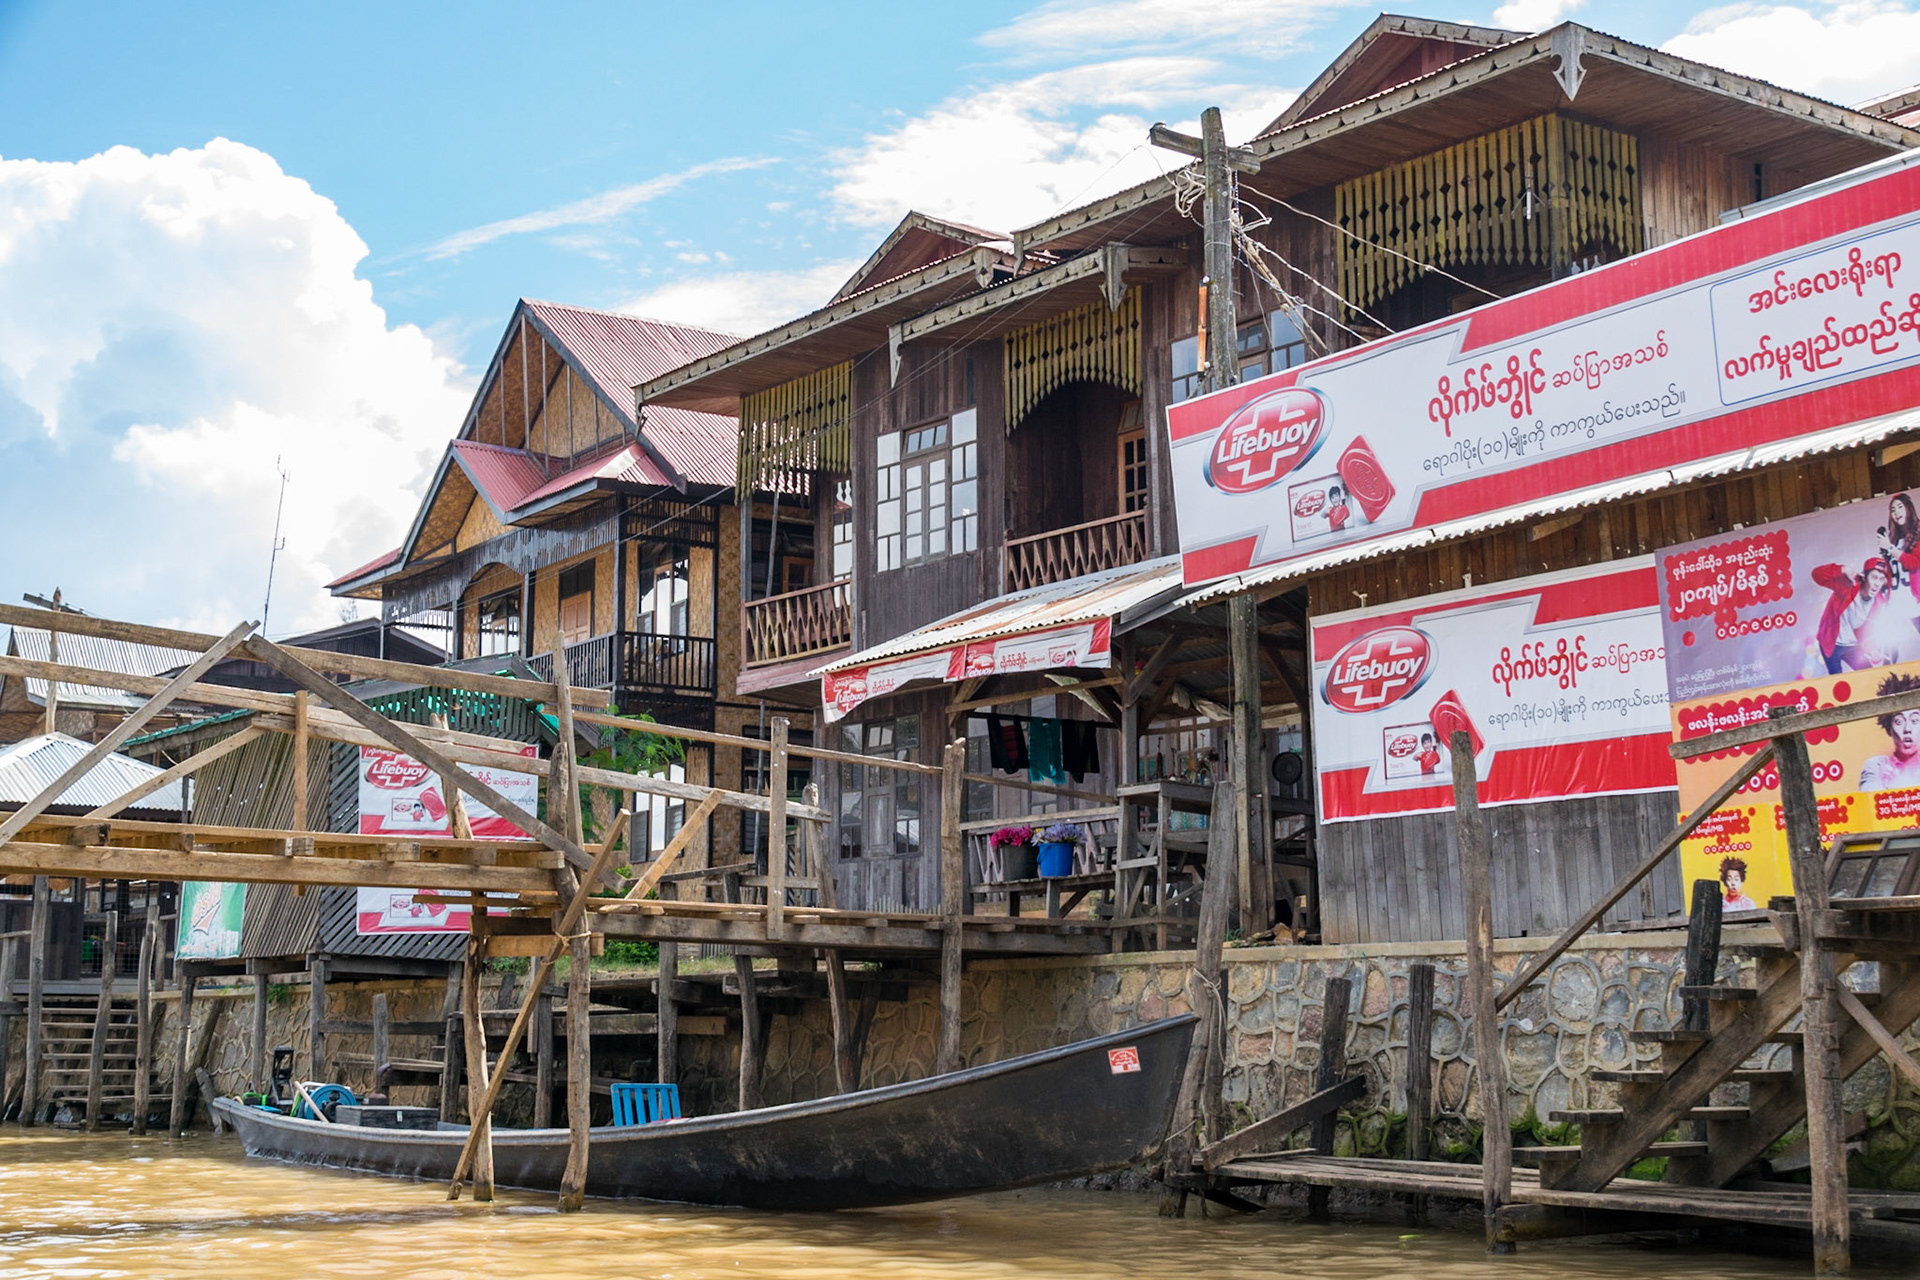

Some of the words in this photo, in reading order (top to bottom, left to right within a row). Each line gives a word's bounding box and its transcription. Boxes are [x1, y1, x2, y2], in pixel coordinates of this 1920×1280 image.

[1748, 247, 1901, 313] အင်းလေးရိုးရာ
[1428, 348, 1546, 437] လိုက်ဖ်ဘွိုင်
[1552, 329, 1669, 390] ဆပ်ပြာအသစ်
[1550, 383, 1686, 439] ကာကွယ်ပေးသည်။
[1216, 418, 1319, 464] Lifebuoy
[1717, 614, 1795, 638] ooredoo
[1333, 656, 1424, 685] Lifebuoy
[1492, 635, 1588, 697] လိုက်ဖ်ဘွိုင်
[372, 763, 429, 779] Lifebuoy
[1739, 765, 1840, 790] oroo
[1879, 807, 1891, 815] 3G
[1705, 843, 1750, 853] ooredoo
